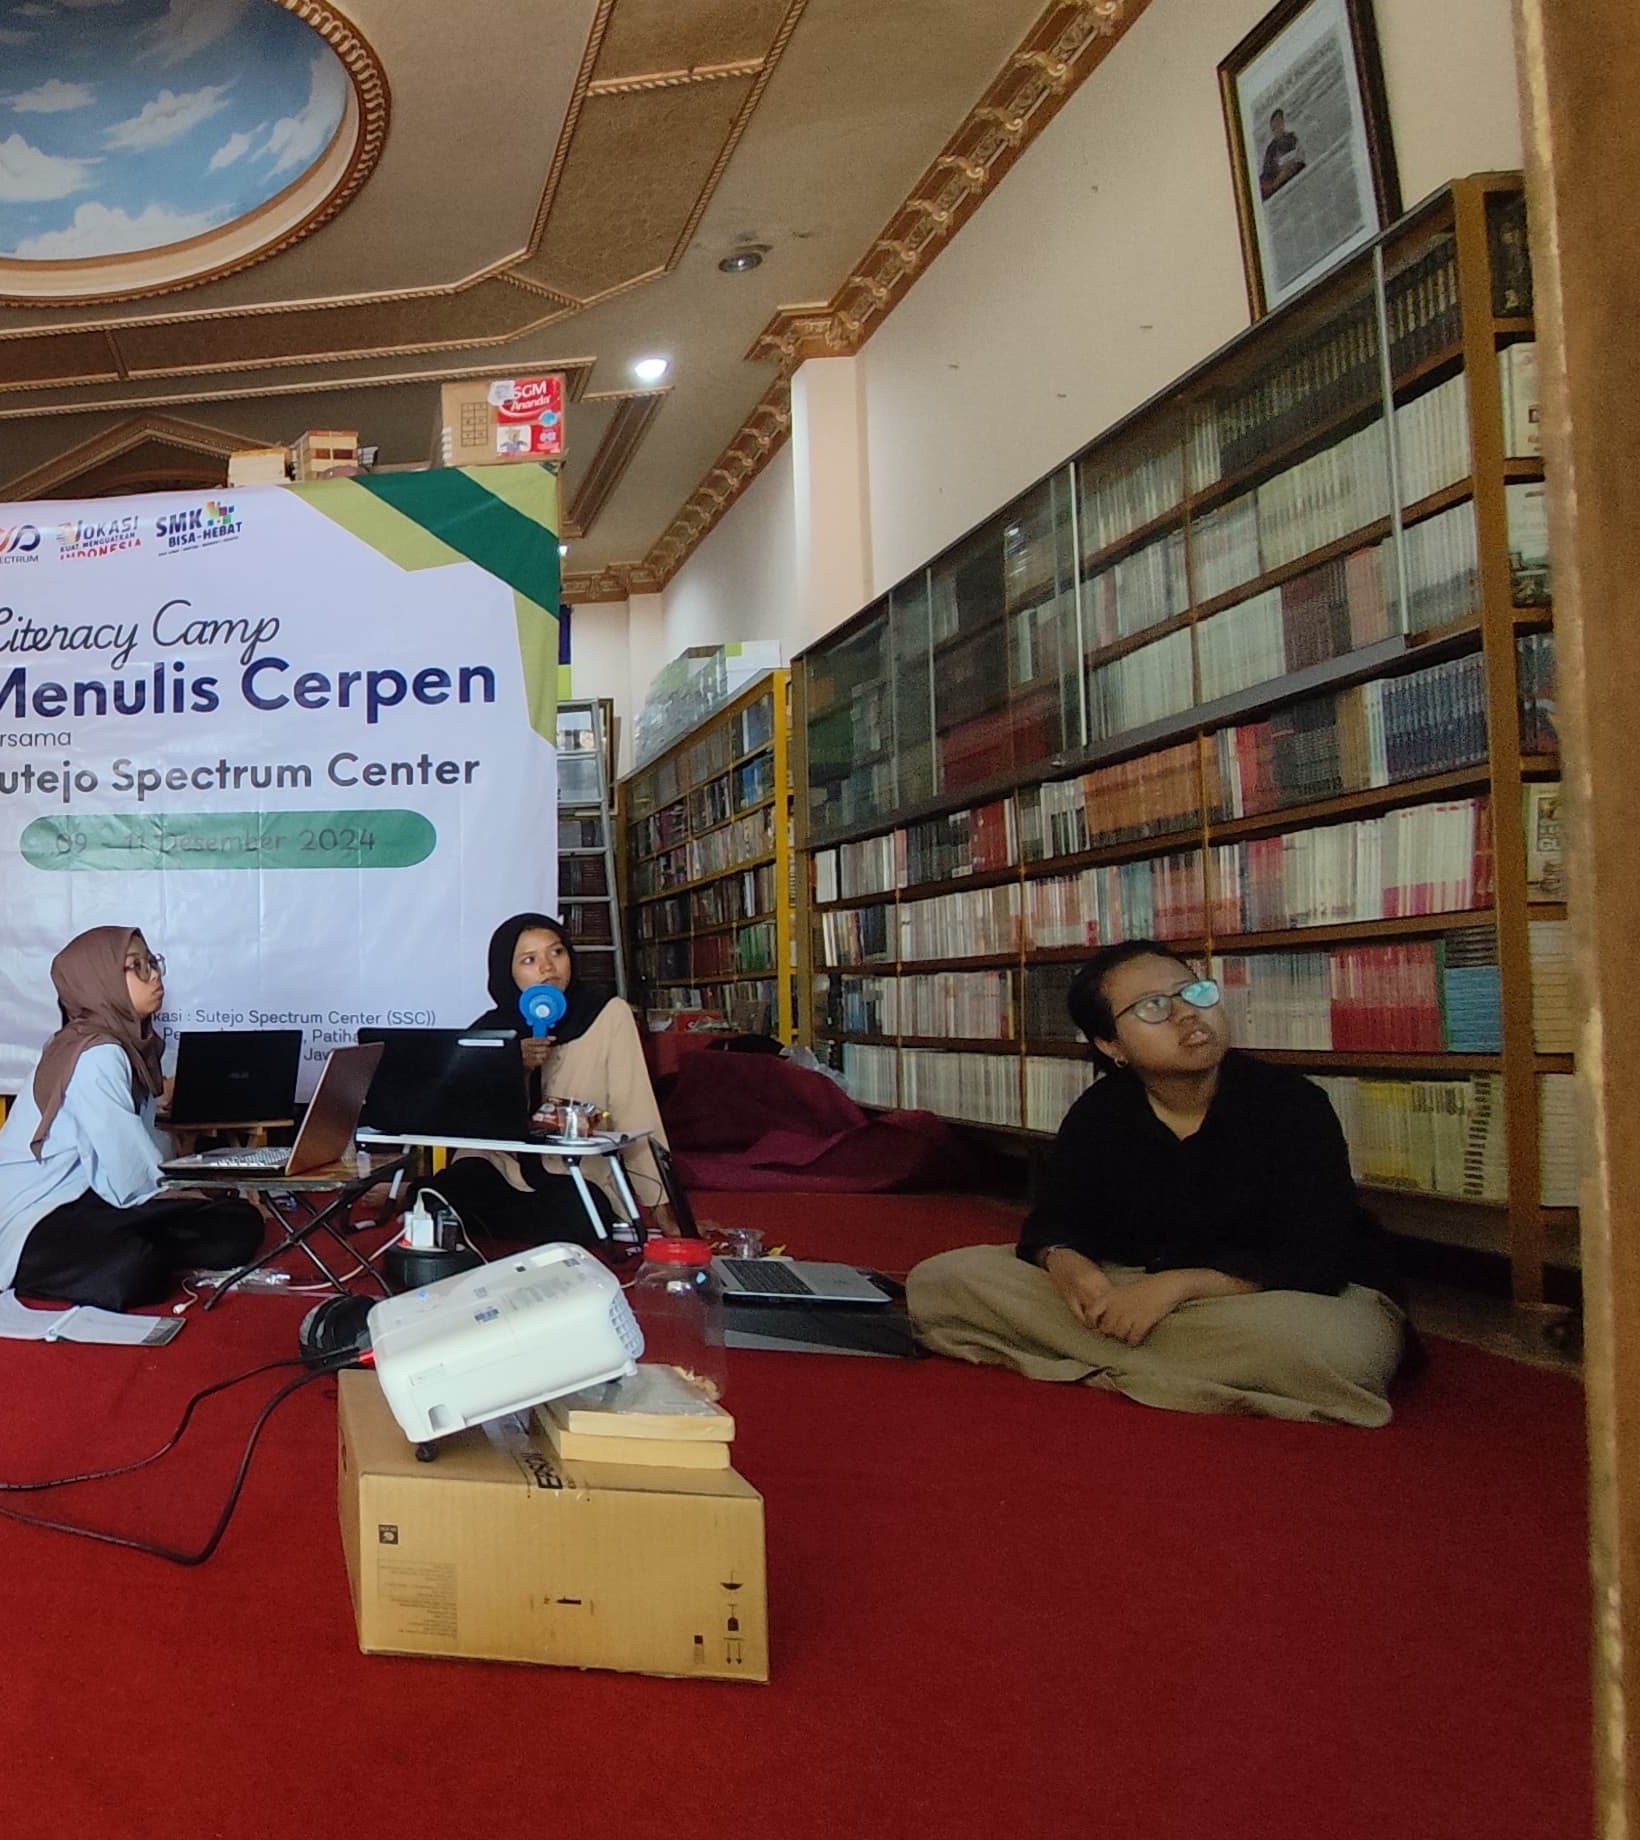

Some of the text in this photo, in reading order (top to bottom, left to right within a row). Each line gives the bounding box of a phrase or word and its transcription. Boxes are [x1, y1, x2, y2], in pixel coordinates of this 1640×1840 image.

[513, 380, 547, 399] SGM
[156, 507, 203, 538] SMK
[168, 521, 243, 548] BISA-HEBAT
[152, 599, 282, 666] Camp
[240, 656, 497, 725] Cerpen
[112, 758, 312, 802] Spectrum
[327, 752, 481, 788] Center
[299, 828, 376, 851] 2024
[196, 1009, 245, 1027] Sutejo
[248, 1010, 323, 1027] Spectrum
[328, 1010, 382, 1025] Center
[387, 1009, 436, 1026] (SSC))
